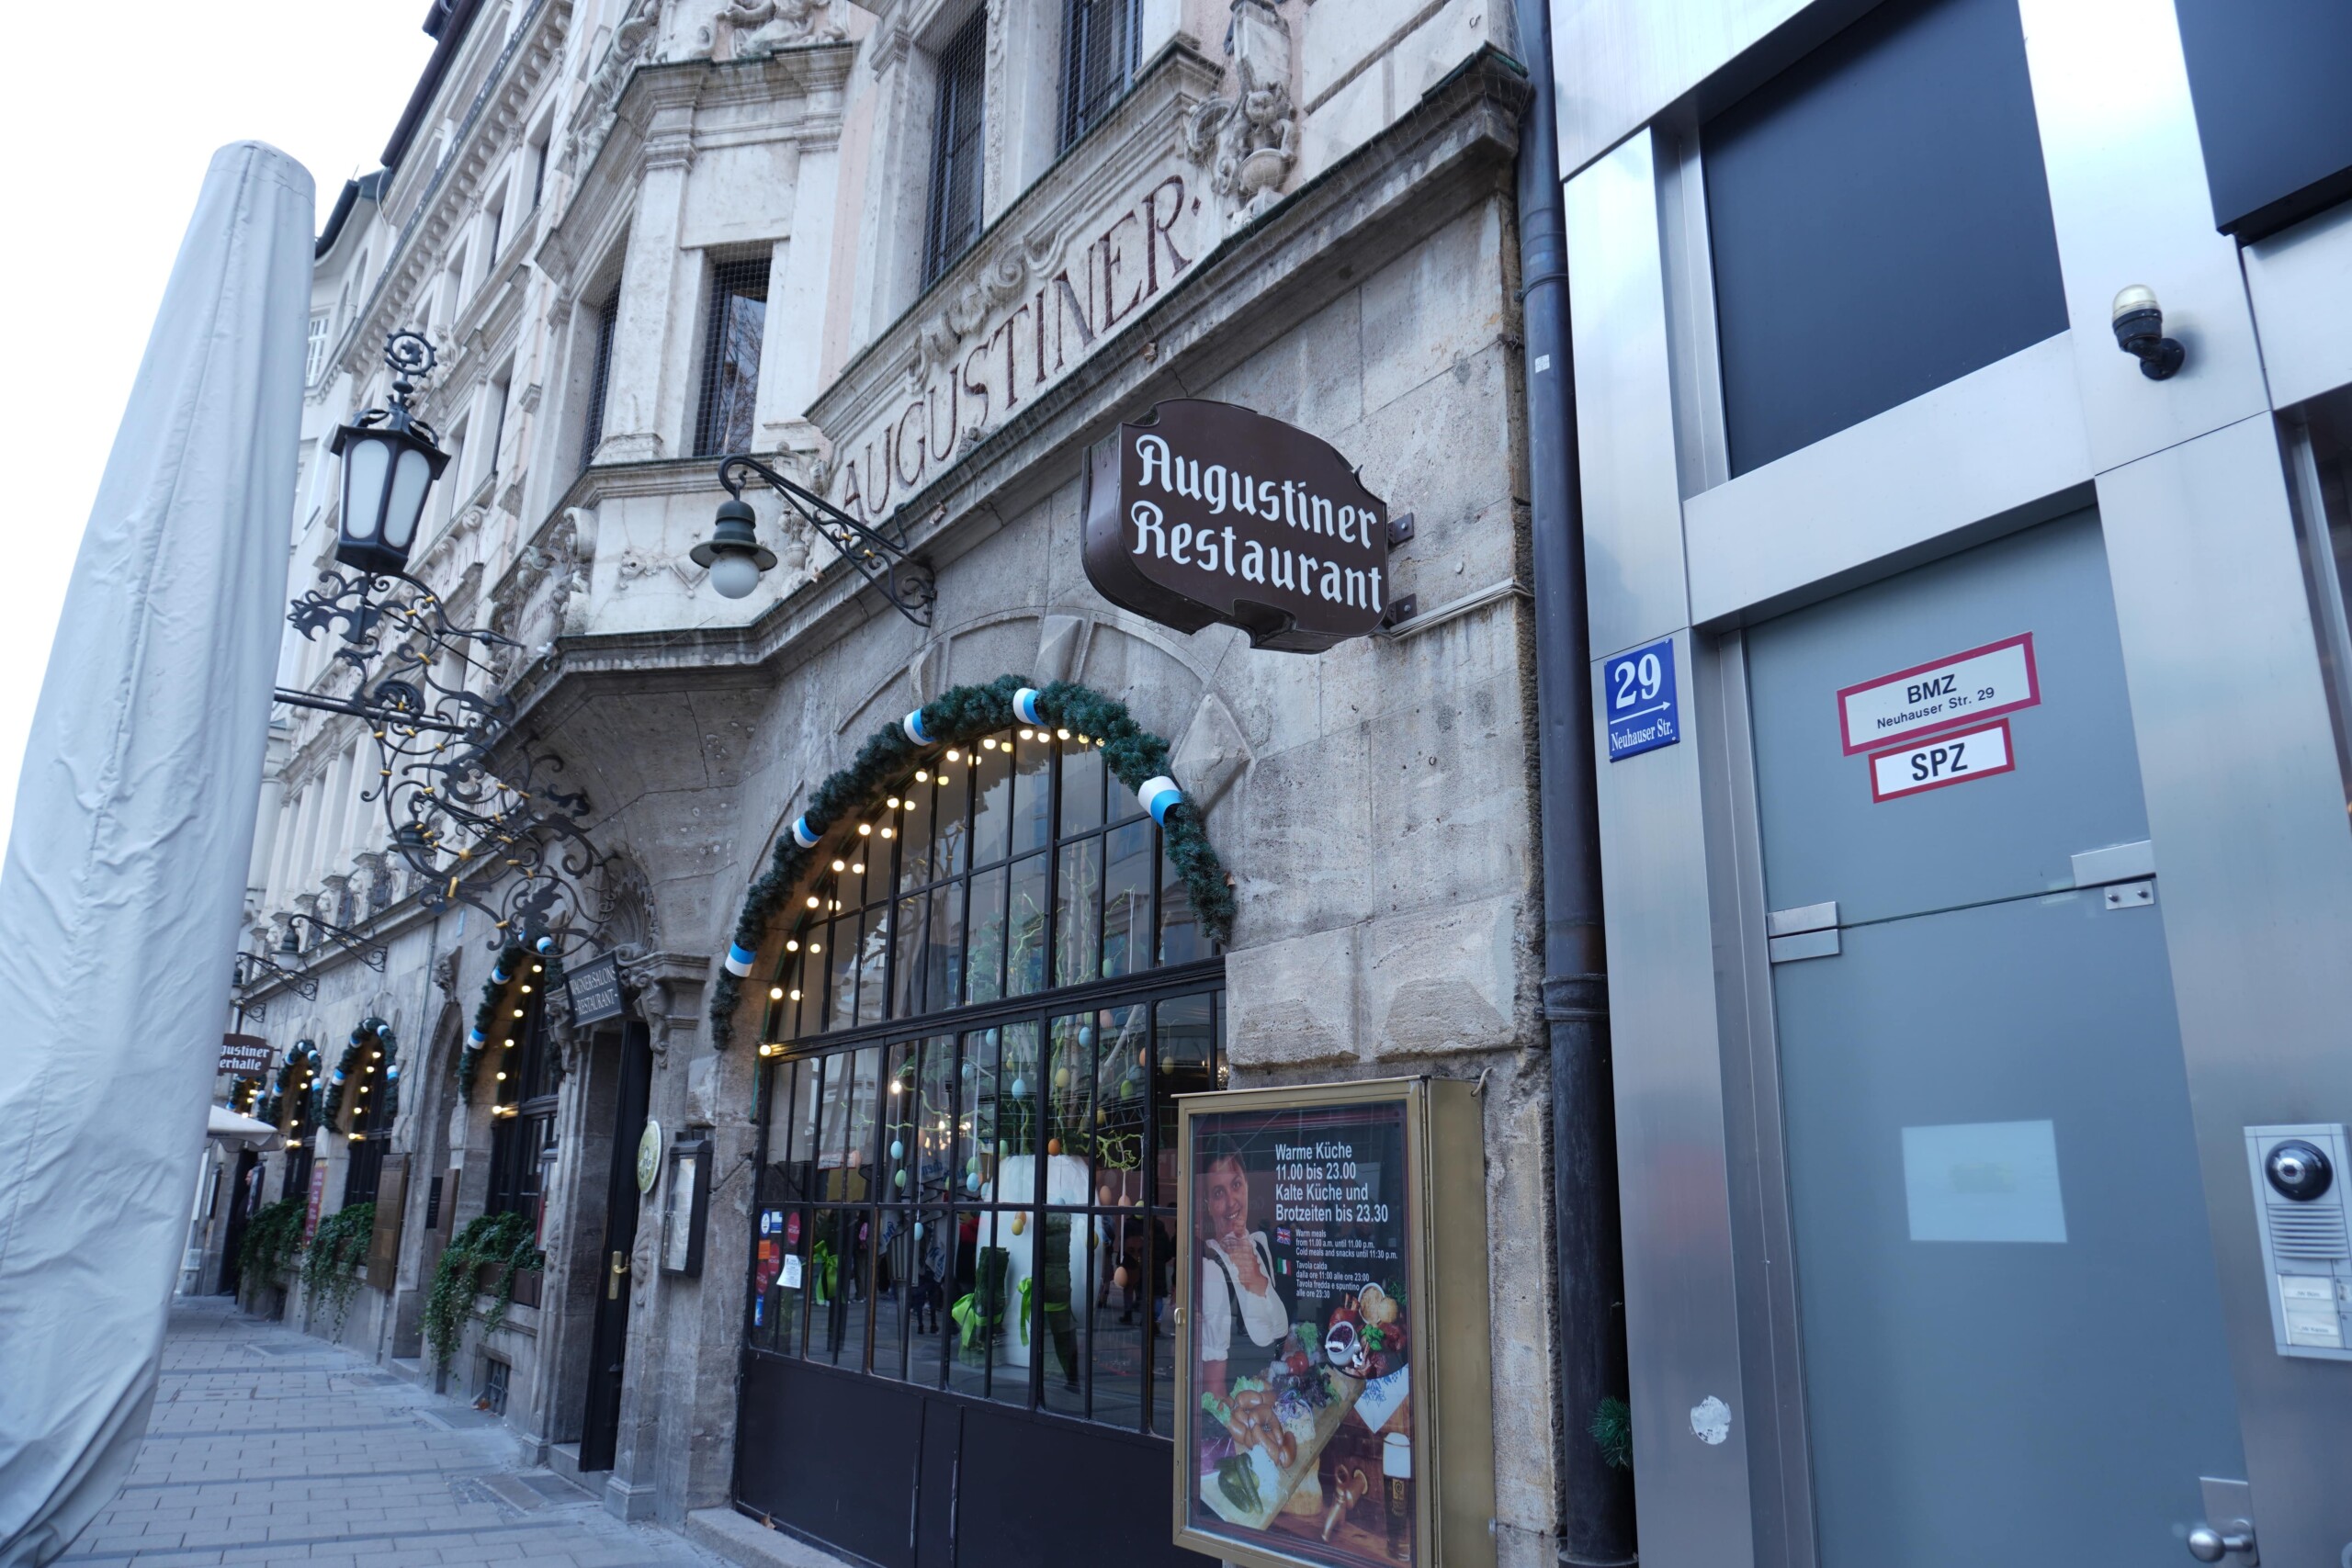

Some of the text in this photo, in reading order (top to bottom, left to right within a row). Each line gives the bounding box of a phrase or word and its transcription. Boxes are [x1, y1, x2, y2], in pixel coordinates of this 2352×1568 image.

[1136, 434, 1377, 549] Augustiner
[1130, 500, 1382, 614] Restaurant
[1614, 653, 1661, 709] 29
[1906, 673, 1957, 705] BMZ
[1876, 687, 1995, 729] Neuhauser Str. 29
[1611, 718, 1673, 751] Neuhauser Str.
[1910, 742, 1968, 782] SPZ
[576, 988, 615, 1016] RESTAURANT
[1275, 1141, 1352, 1161] Warme Küche
[1275, 1162, 1357, 1180] 11.00 bis 23.00
[1275, 1182, 1369, 1201] Kalte Küche und
[1275, 1203, 1388, 1223] Brotzeiten bis 23.30
[1295, 1228, 1327, 1237] Warm meals
[1295, 1238, 1308, 1247] from
[1308, 1238, 1322, 1247] 11.00
[1334, 1238, 1347, 1247] until
[1348, 1239, 1363, 1248] 11.00
[1363, 1241, 1375, 1250] p.m.
[1295, 1248, 1397, 1260] Cold meals and snacks until 11:30 p.m.
[1295, 1260, 1328, 1270] Tavola calda
[1295, 1270, 1309, 1279] dalla
[1318, 1271, 1333, 1280] 11:00
[1334, 1271, 1343, 1280] alle
[1354, 1272, 1370, 1281] 23:00
[1295, 1280, 1313, 1288] Tavola
[1313, 1280, 1331, 1290] fredda
[1335, 1282, 1360, 1292] spuntino
[1295, 1289, 1306, 1297] alle
[1316, 1290, 1330, 1299] 23:30
